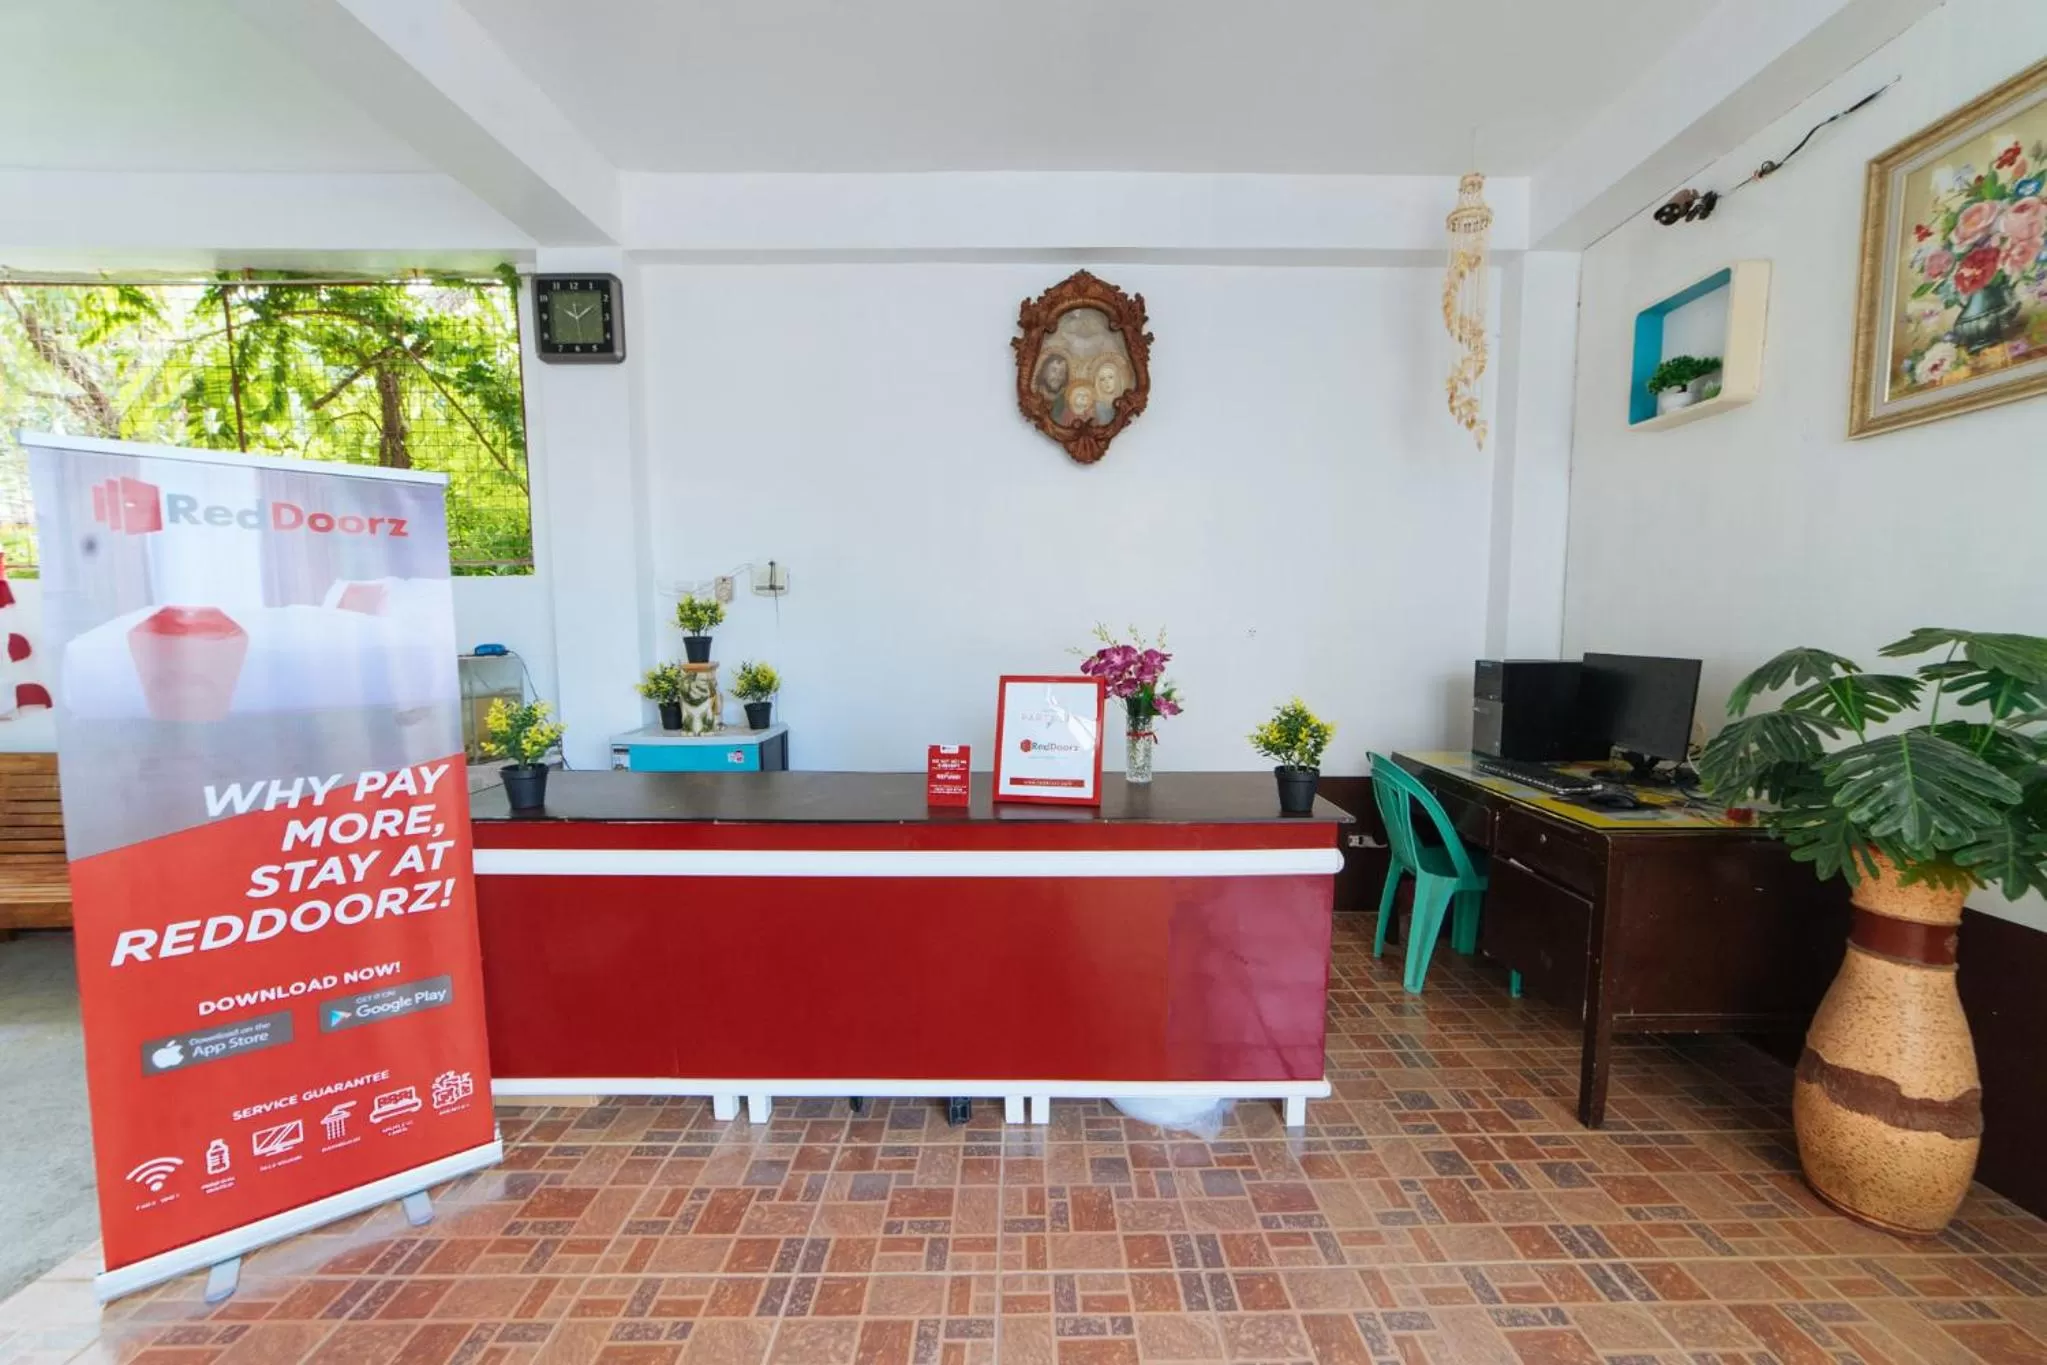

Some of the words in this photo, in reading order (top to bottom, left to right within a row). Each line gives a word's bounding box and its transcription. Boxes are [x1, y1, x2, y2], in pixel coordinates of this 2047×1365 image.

[552, 282, 560, 290] 11
[569, 281, 579, 290] 12
[166, 493, 408, 537] RedDoorz
[203, 772, 341, 817] WHY
[352, 763, 450, 801] PAY
[281, 804, 446, 851] MORE,
[245, 850, 381, 898] STAY
[389, 840, 454, 877] AT
[110, 878, 456, 967] REDDOORZ!
[198, 974, 338, 1016] DOWNLOAD
[343, 961, 401, 984] NOW!
[356, 996, 413, 1017] Google
[414, 989, 447, 1004] Play
[188, 1028, 239, 1046] Download
[239, 1026, 253, 1035] on
[255, 1022, 271, 1031] the
[192, 1042, 226, 1058] App
[229, 1032, 270, 1048] Store
[232, 1094, 299, 1121] SERVICE
[302, 1069, 391, 1101] GUARANTEE
